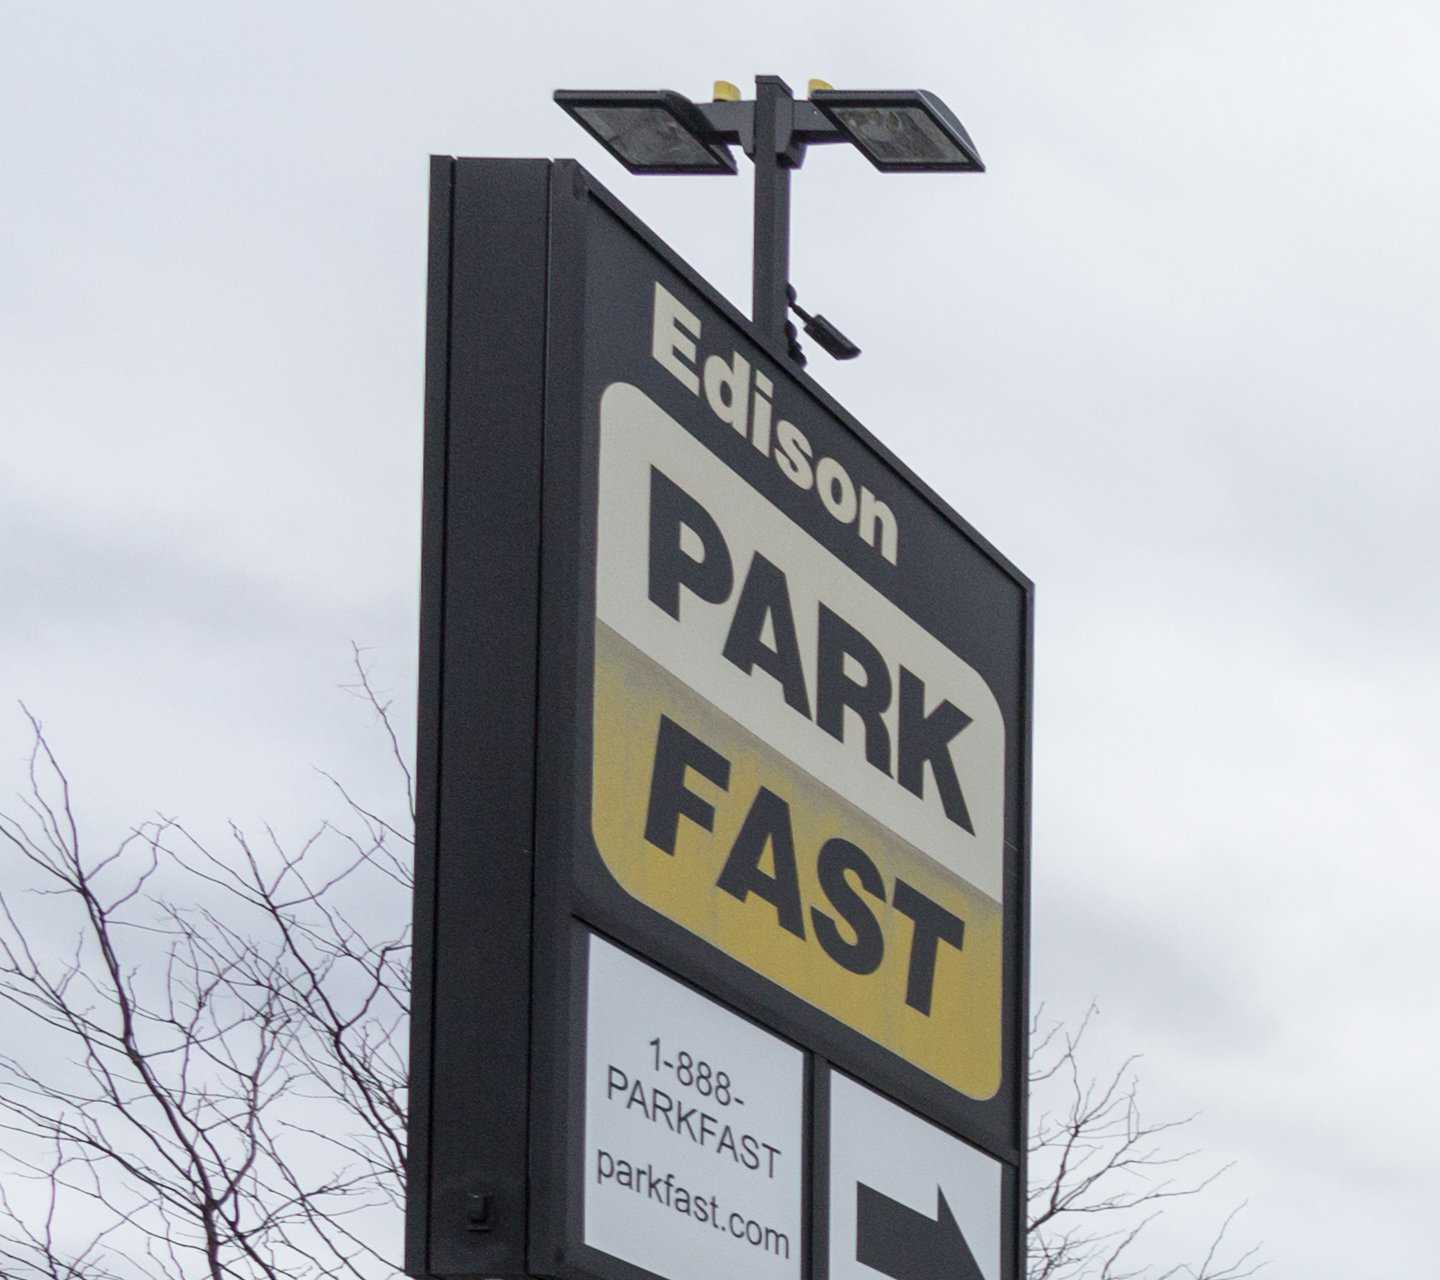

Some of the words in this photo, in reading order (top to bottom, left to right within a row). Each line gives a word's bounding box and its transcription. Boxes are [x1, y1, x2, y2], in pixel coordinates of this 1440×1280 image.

[652, 281, 898, 566] Edison
[649, 463, 976, 837] PARK
[644, 713, 965, 1017] FAST
[607, 1065, 781, 1179] PARKFAST
[650, 1038, 745, 1106] 1-888-
[597, 1149, 790, 1260] parkfast.com
